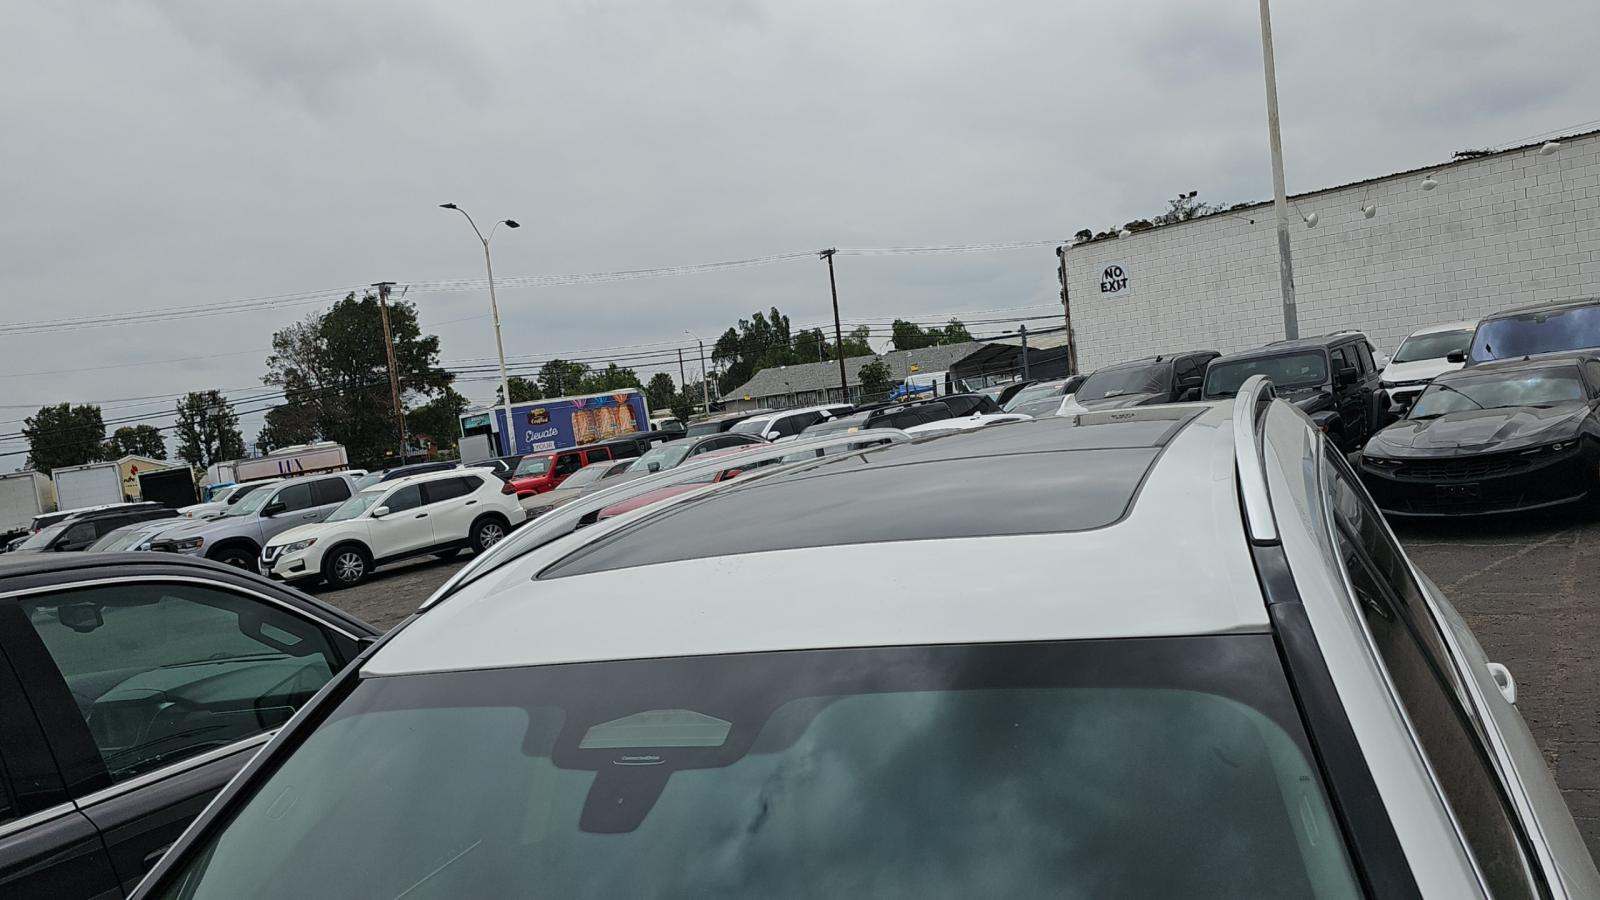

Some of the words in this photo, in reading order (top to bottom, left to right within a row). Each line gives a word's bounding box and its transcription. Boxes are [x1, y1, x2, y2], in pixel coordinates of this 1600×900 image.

[1104, 267, 1123, 279] NO
[1100, 278, 1128, 293] EXIT
[525, 427, 559, 443] Elevate
